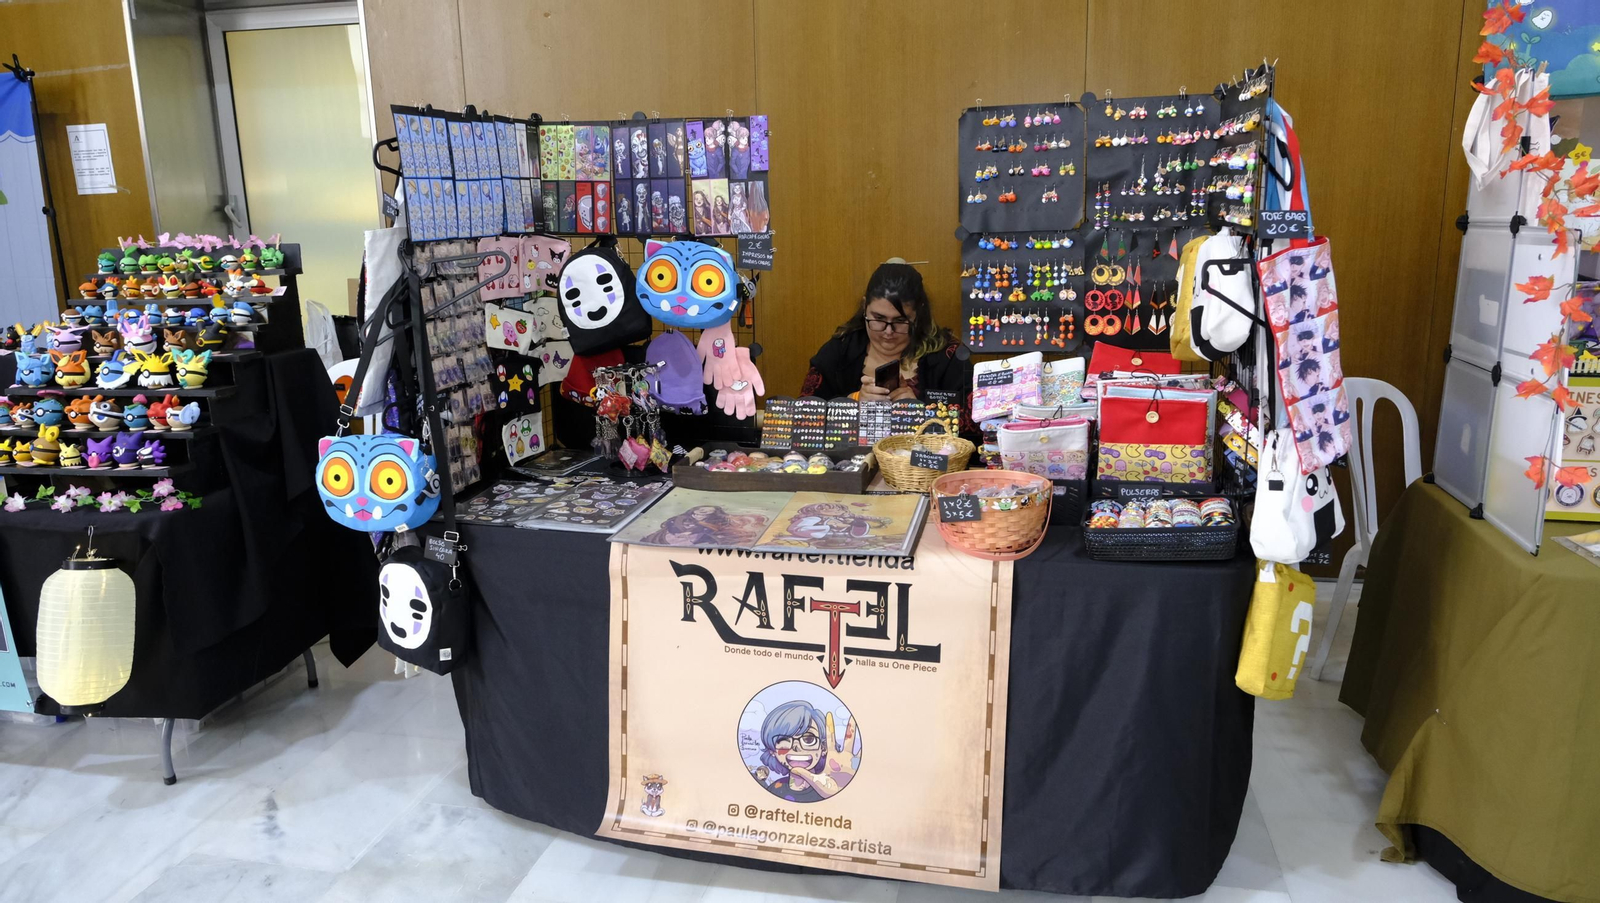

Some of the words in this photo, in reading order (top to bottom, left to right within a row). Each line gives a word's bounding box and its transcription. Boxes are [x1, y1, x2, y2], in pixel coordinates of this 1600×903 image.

[1261, 212, 1284, 220] TOTE
[1285, 212, 1306, 221] BAGS
[1121, 488, 1159, 496] PULSERAS
[669, 559, 941, 689] RAFTEL
[724, 646, 751, 655] Donde
[754, 648, 772, 657] todo
[785, 653, 814, 661] mundo
[856, 658, 876, 667] halla
[892, 662, 910, 670] One
[913, 664, 937, 672] Piece
[744, 804, 852, 830] @raftel.tienda
[702, 820, 892, 856] @paulagonzalezs.artista
